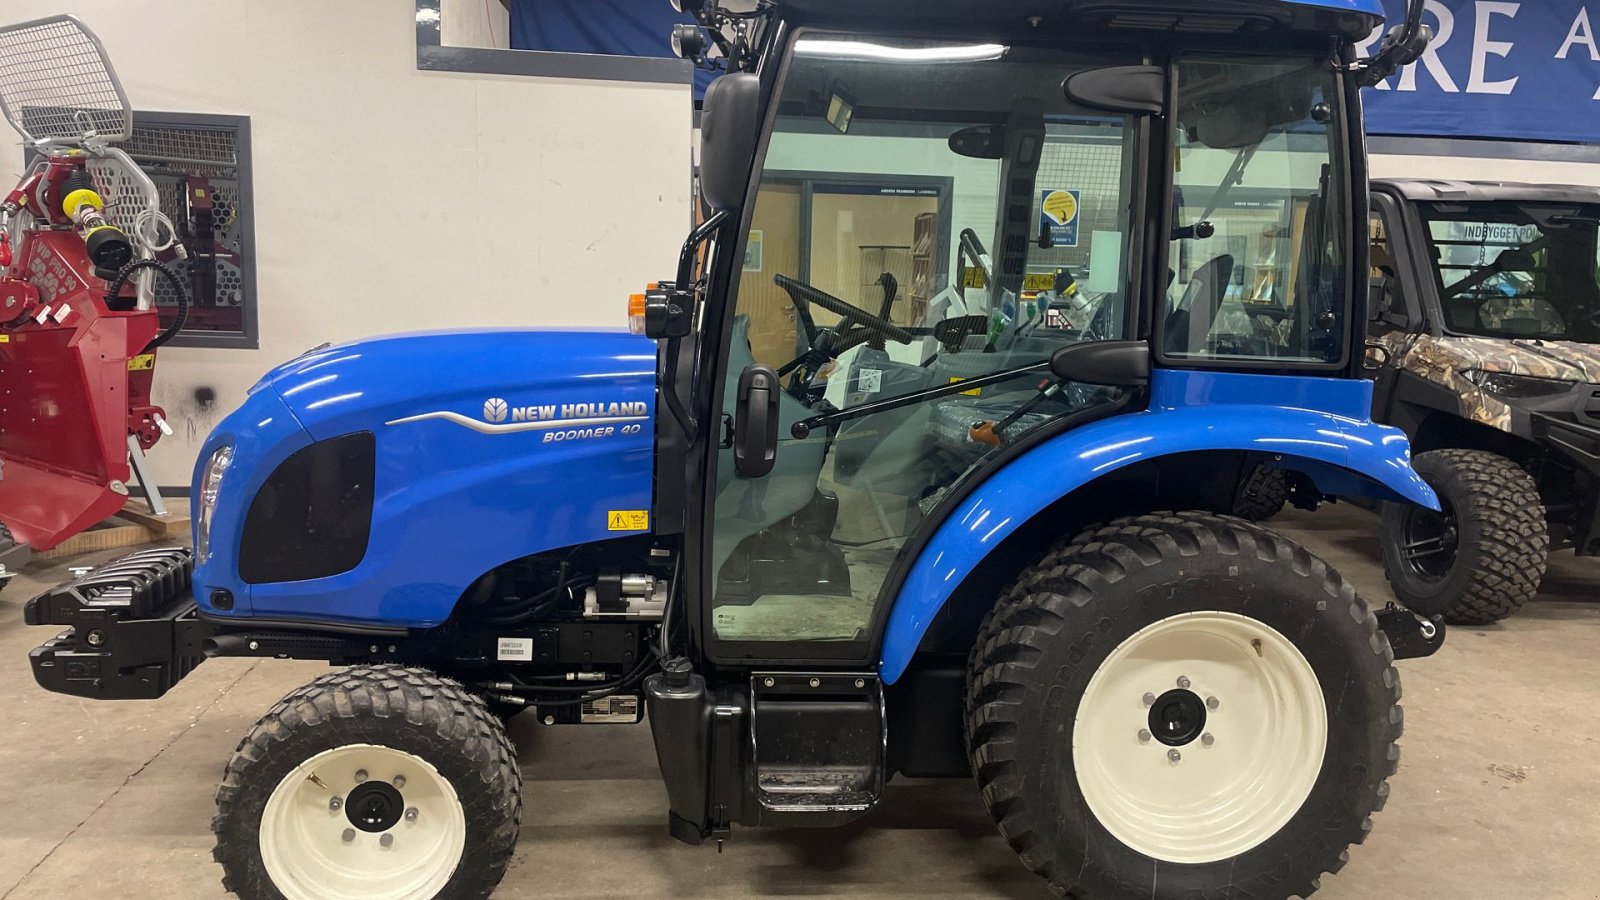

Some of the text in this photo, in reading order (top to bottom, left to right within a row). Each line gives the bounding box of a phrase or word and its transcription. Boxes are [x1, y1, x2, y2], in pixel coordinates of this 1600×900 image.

[49, 257, 67, 279] PRO
[511, 401, 648, 421] NEW HOLLAND
[542, 424, 641, 443] BOOMER 40
